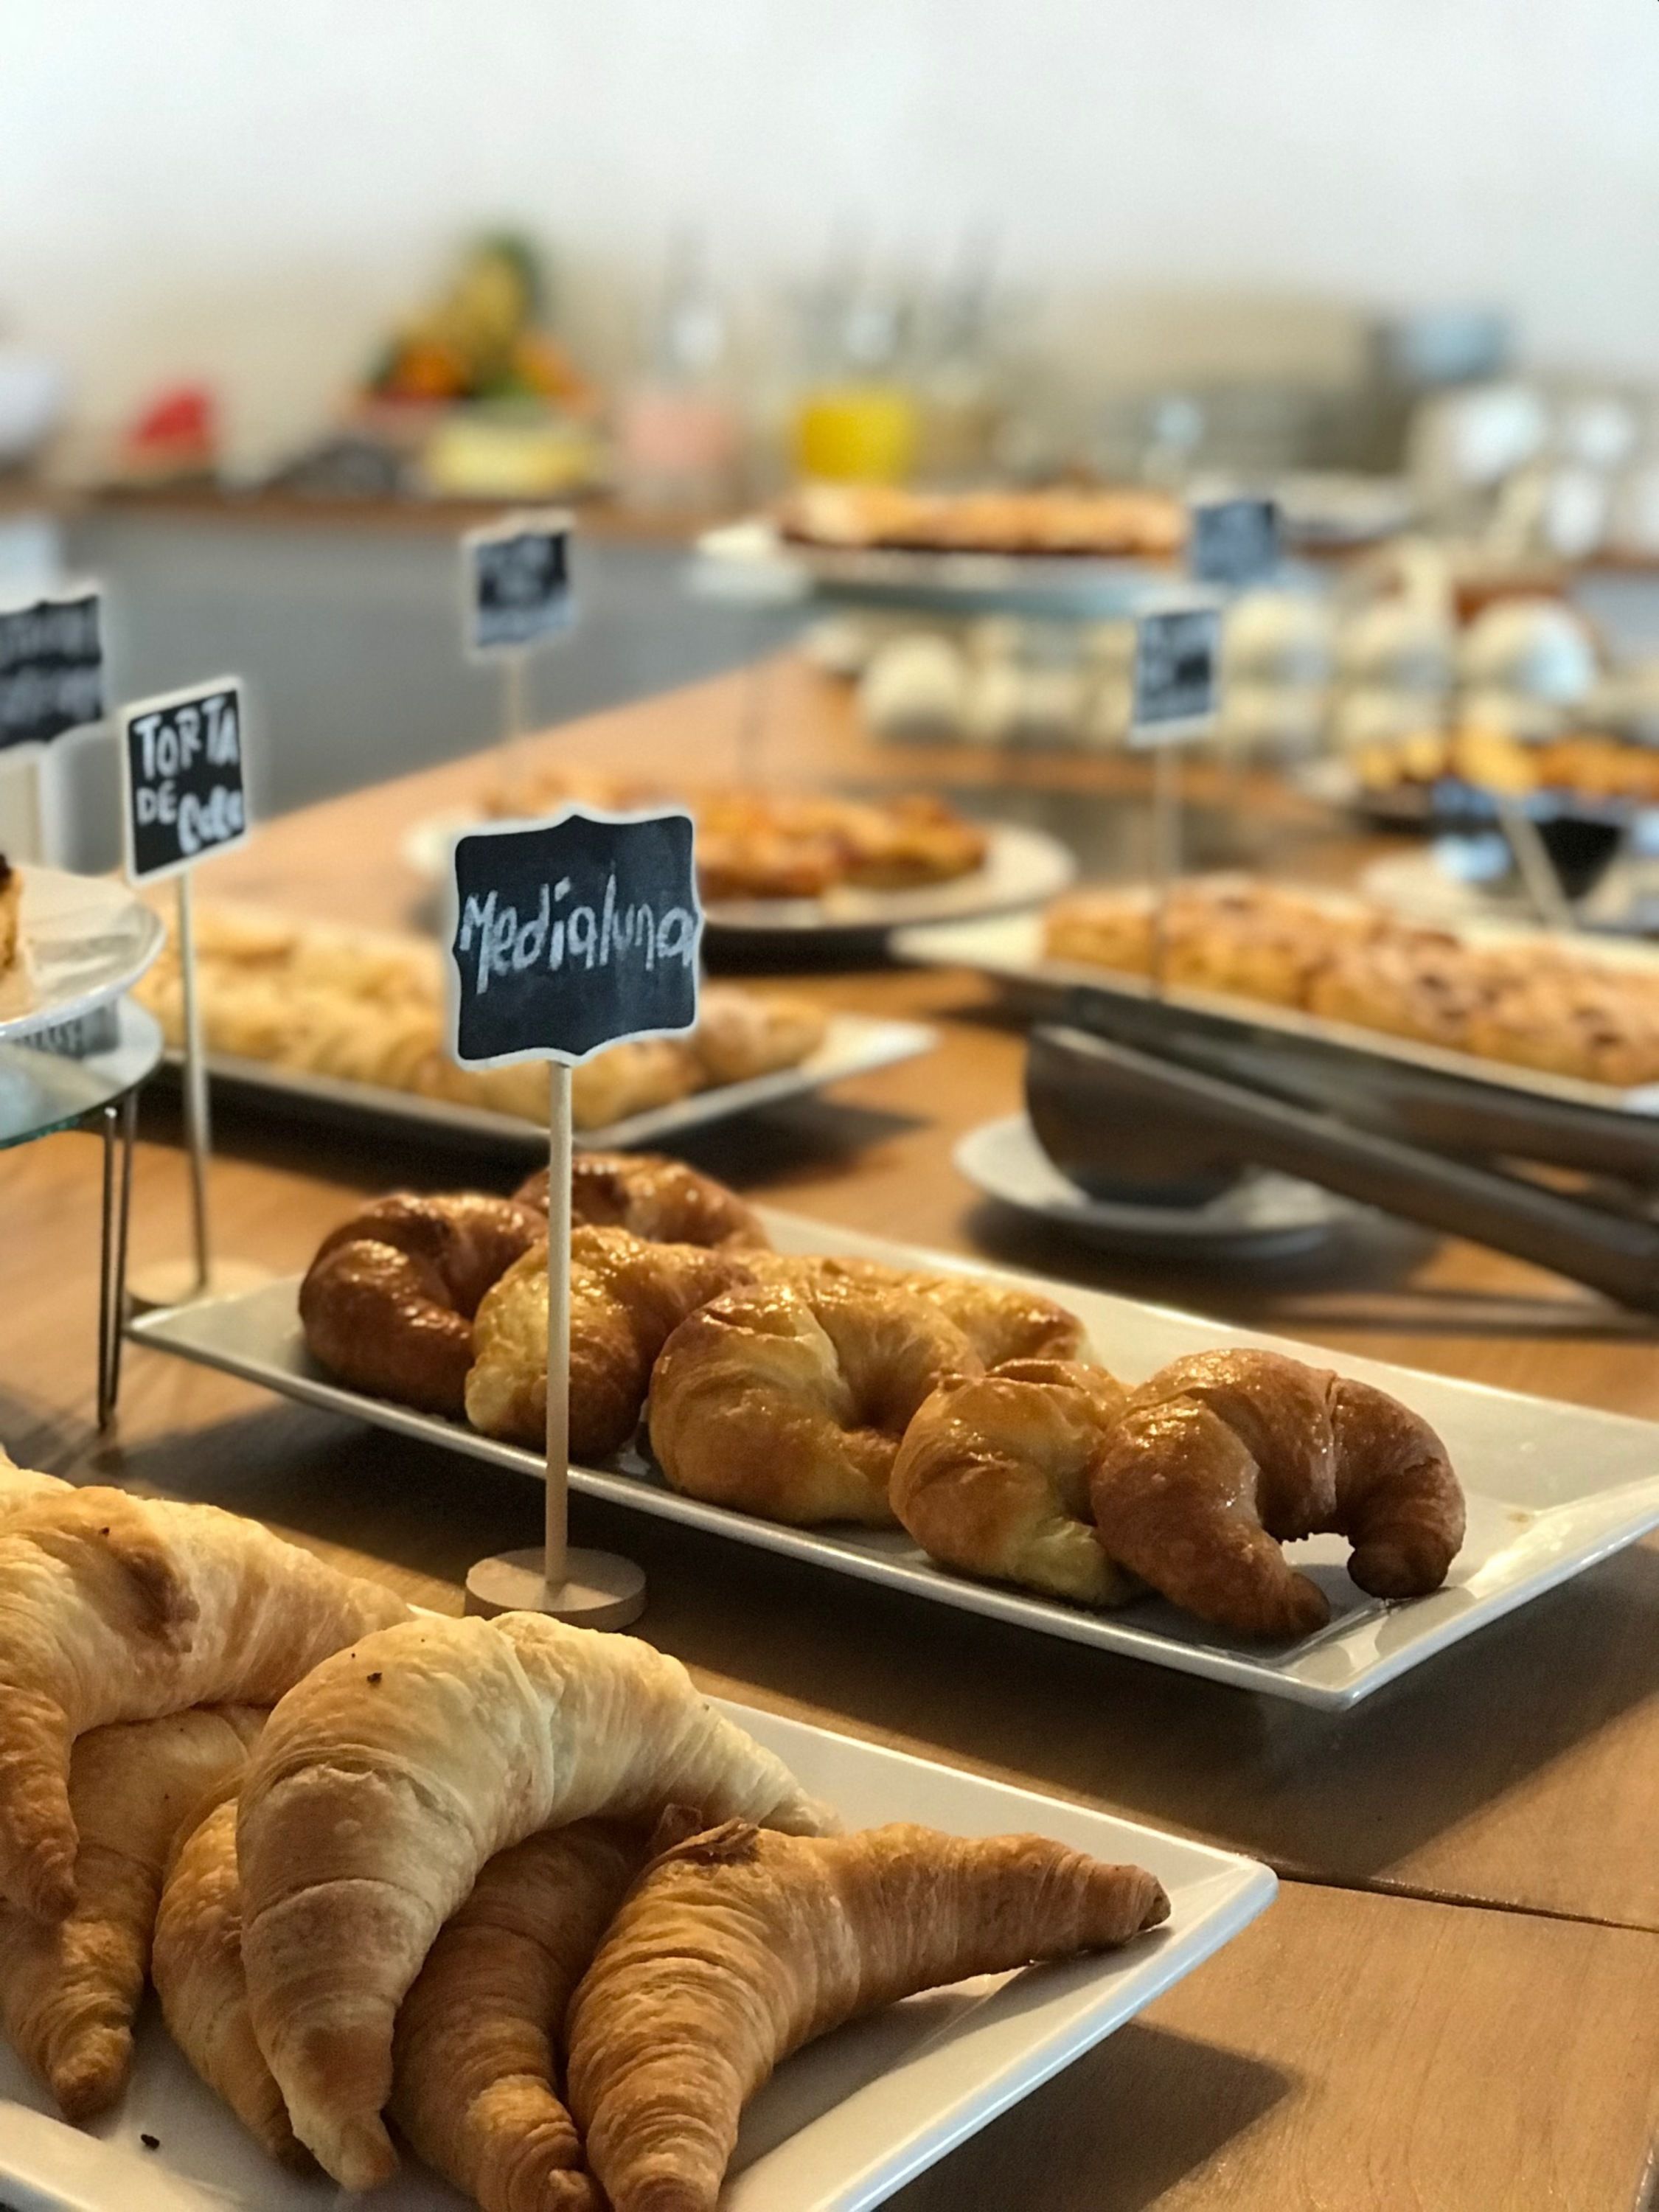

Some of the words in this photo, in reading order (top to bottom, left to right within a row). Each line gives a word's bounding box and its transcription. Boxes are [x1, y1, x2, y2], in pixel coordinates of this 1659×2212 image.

[133, 696, 239, 780] TORTA
[136, 779, 176, 825] DE
[459, 873, 695, 995] Medialuna
